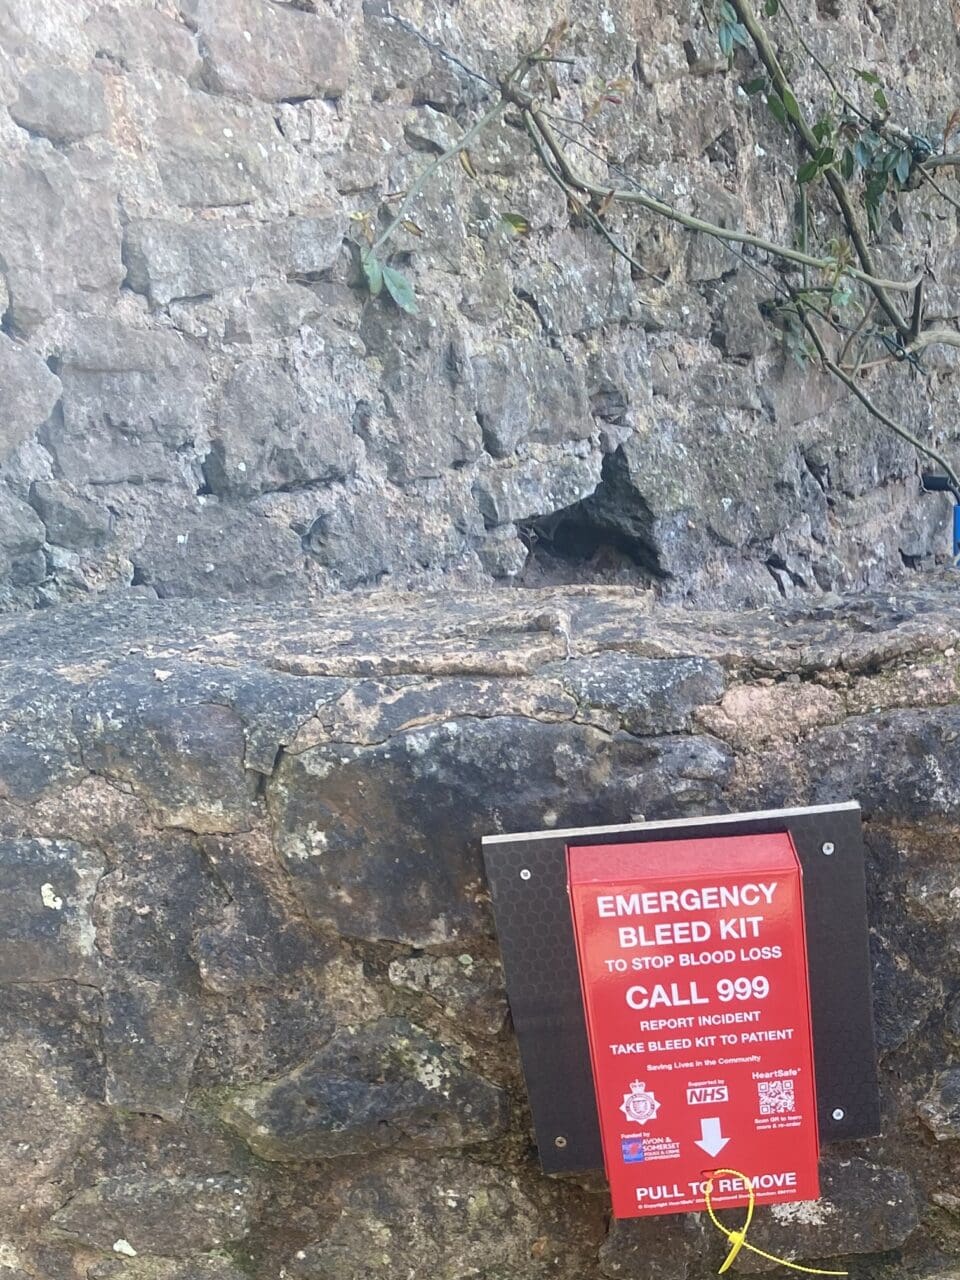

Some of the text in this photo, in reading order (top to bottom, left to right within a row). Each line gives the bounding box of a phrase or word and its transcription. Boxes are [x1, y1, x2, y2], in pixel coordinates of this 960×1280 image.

[597, 882, 778, 918] EMERGENCY
[618, 916, 764, 948] BLEED KIT
[604, 946, 782, 972] TO STOP BLOOD LOSS
[625, 976, 770, 1010] CALL 999
[640, 1011, 761, 1032] REPORT INCIDENT
[609, 1029, 794, 1055] TAKE BLEED KIT TO PATIENT
[646, 1063, 673, 1072] Saving
[674, 1060, 694, 1069] Lives
[704, 1058, 717, 1066] the
[718, 1054, 762, 1065] Community
[689, 1087, 726, 1103] NHS
[643, 1142, 680, 1151] SOMERSET
[636, 1172, 797, 1201] PULL TO REMOVE
